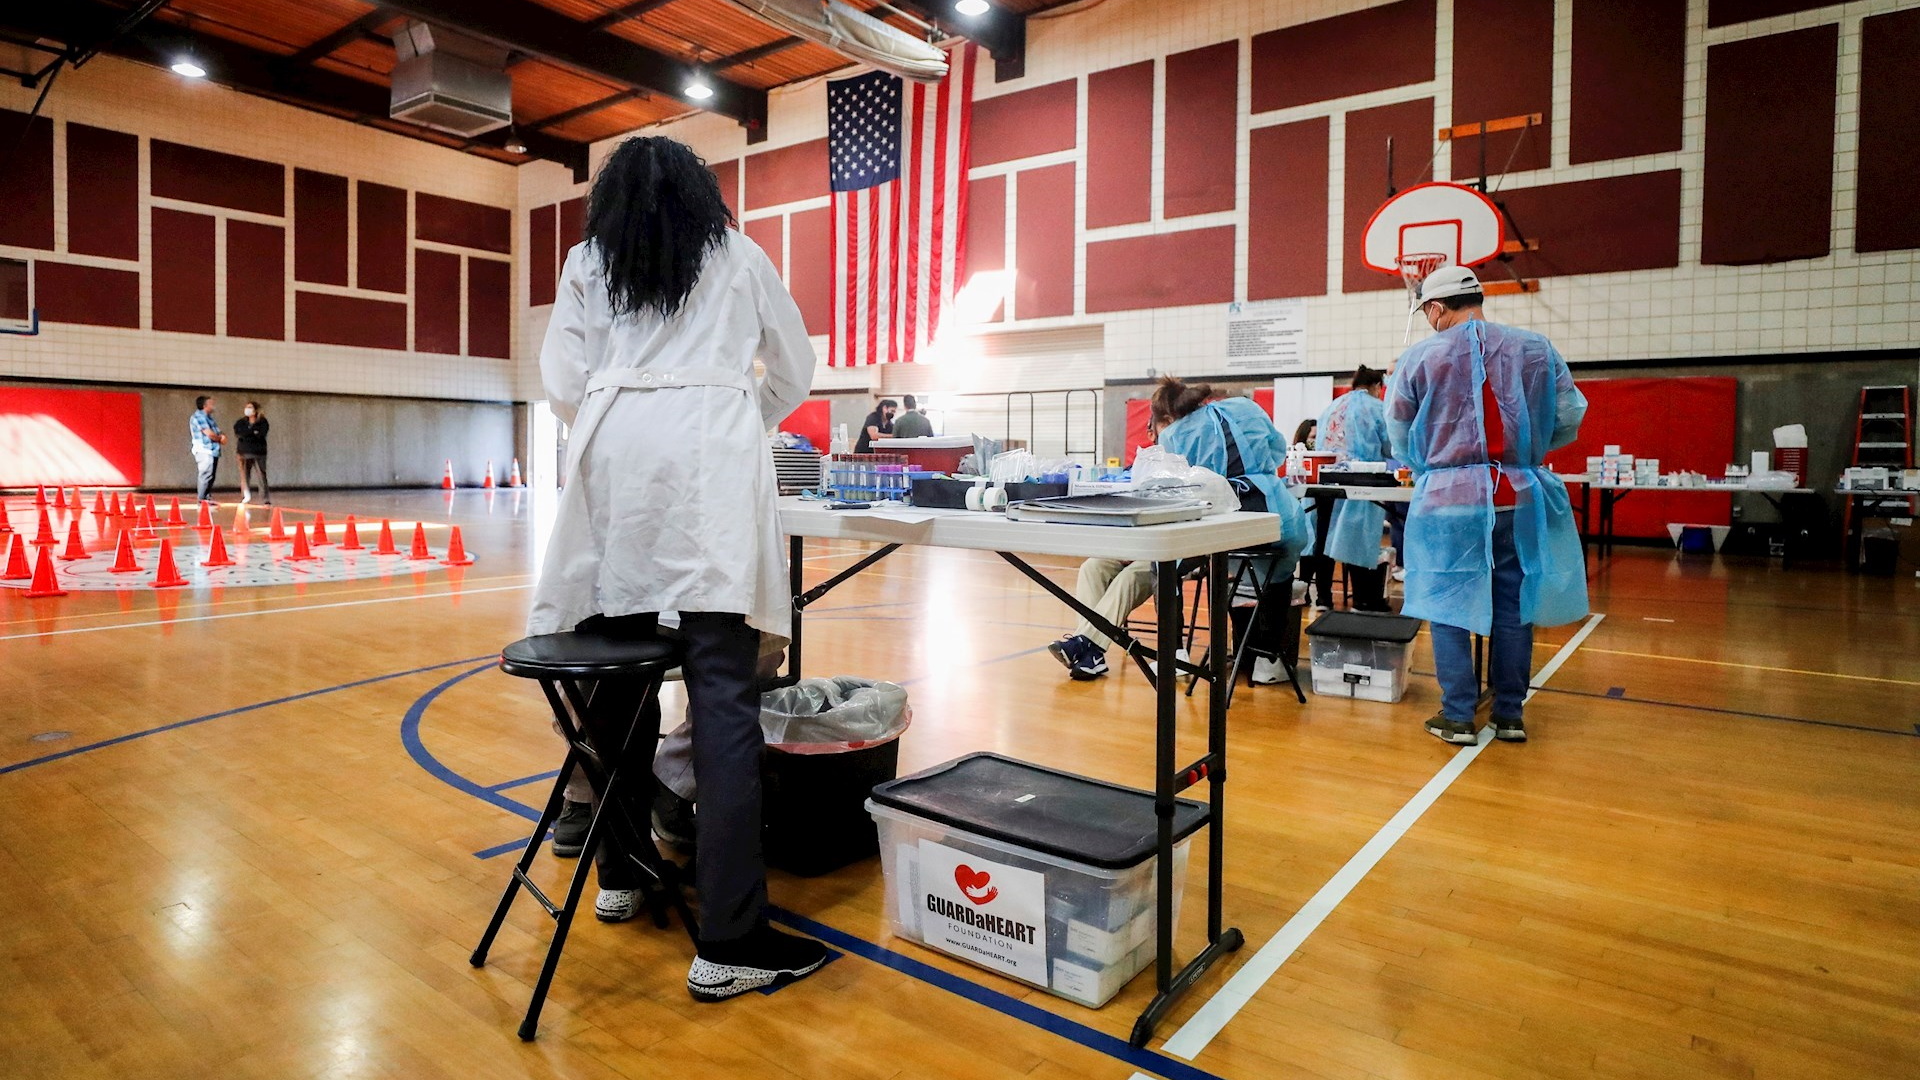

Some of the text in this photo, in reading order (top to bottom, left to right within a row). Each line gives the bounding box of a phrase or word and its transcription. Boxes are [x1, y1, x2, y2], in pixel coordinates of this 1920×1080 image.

[927, 893, 1036, 945] GUARDaHEART
[948, 923, 1013, 950] FOUNDATION
[945, 937, 1017, 967] www.GUARDaHEART.org
